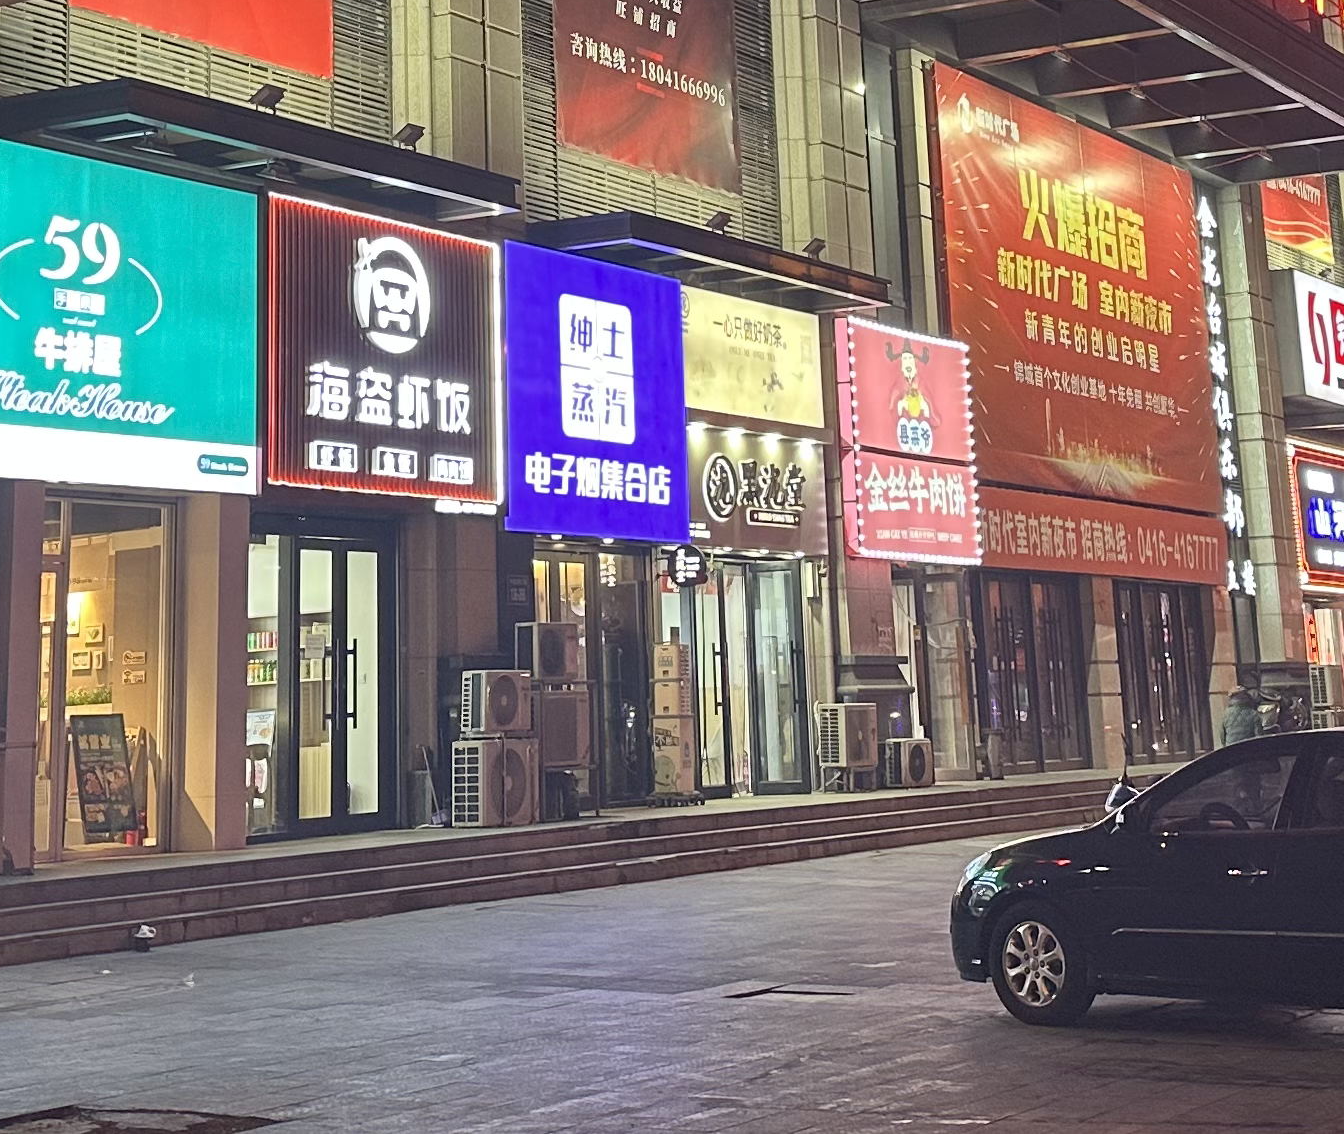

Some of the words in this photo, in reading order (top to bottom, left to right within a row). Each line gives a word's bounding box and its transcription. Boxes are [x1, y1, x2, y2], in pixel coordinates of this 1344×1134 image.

[40, 215, 121, 285] 59
[1019, 169, 1147, 280] 火爆招商
[997, 247, 1088, 310] 新时代广场
[1098, 279, 1172, 335] 室内新夜市
[34, 327, 122, 377] 牛排屋
[569, 312, 625, 360] 绅士
[1024, 308, 1160, 374] 新青年的创业启明星
[70, 382, 175, 424] House
[305, 360, 472, 435] 海盗虾饭
[571, 382, 627, 427] 蒸汽
[525, 452, 671, 505] 电子烟集合店
[864, 462, 966, 517] 金丝牛肉饼
